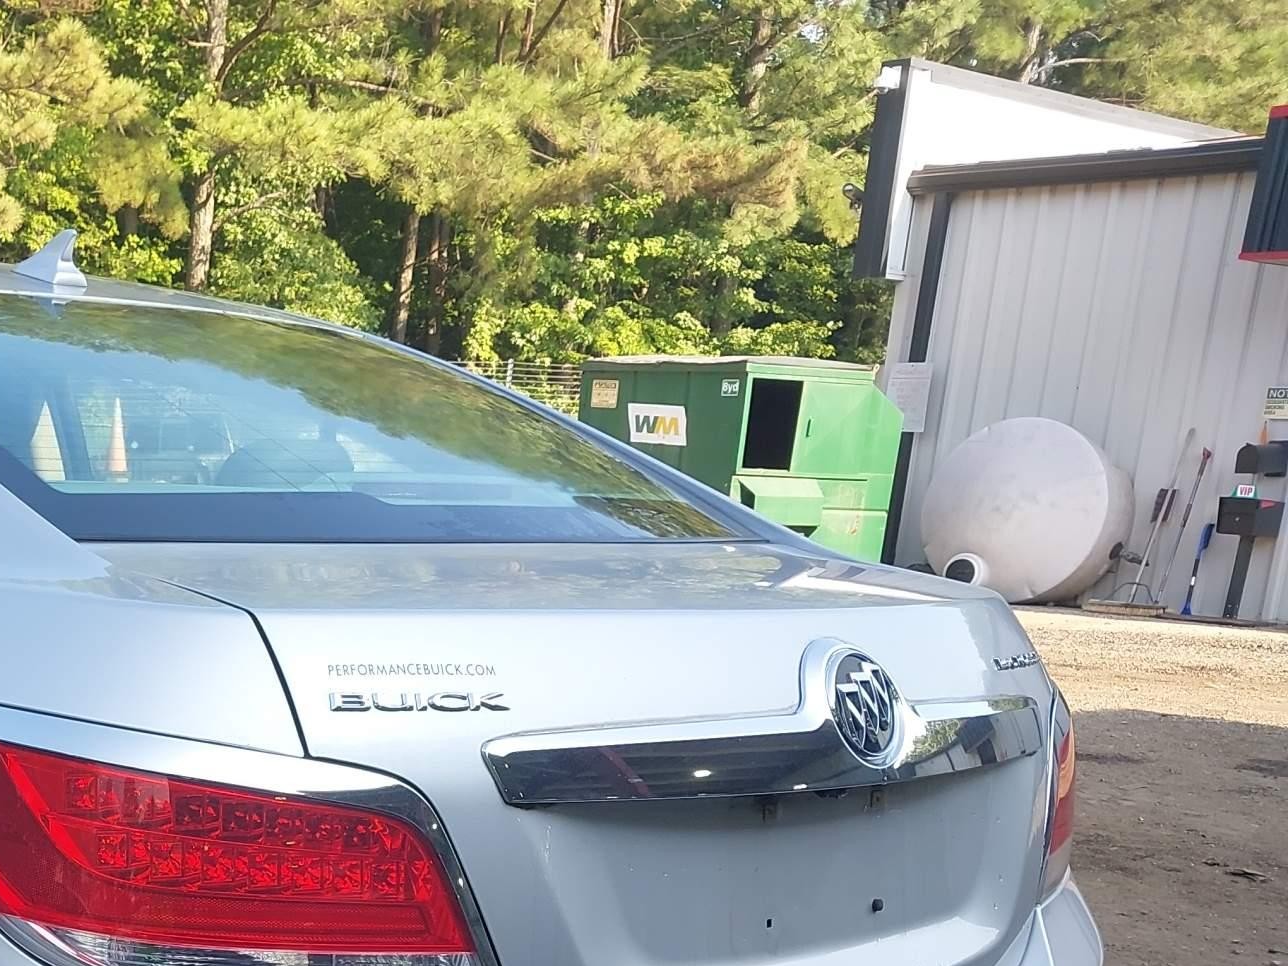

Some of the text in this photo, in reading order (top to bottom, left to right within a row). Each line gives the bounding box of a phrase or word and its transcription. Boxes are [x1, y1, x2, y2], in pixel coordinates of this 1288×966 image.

[635, 414, 679, 435] WM
[1239, 486, 1253, 496] VIP
[327, 663, 497, 677] PERFORMANCEBUICK.COM
[328, 692, 511, 712] BUICK
